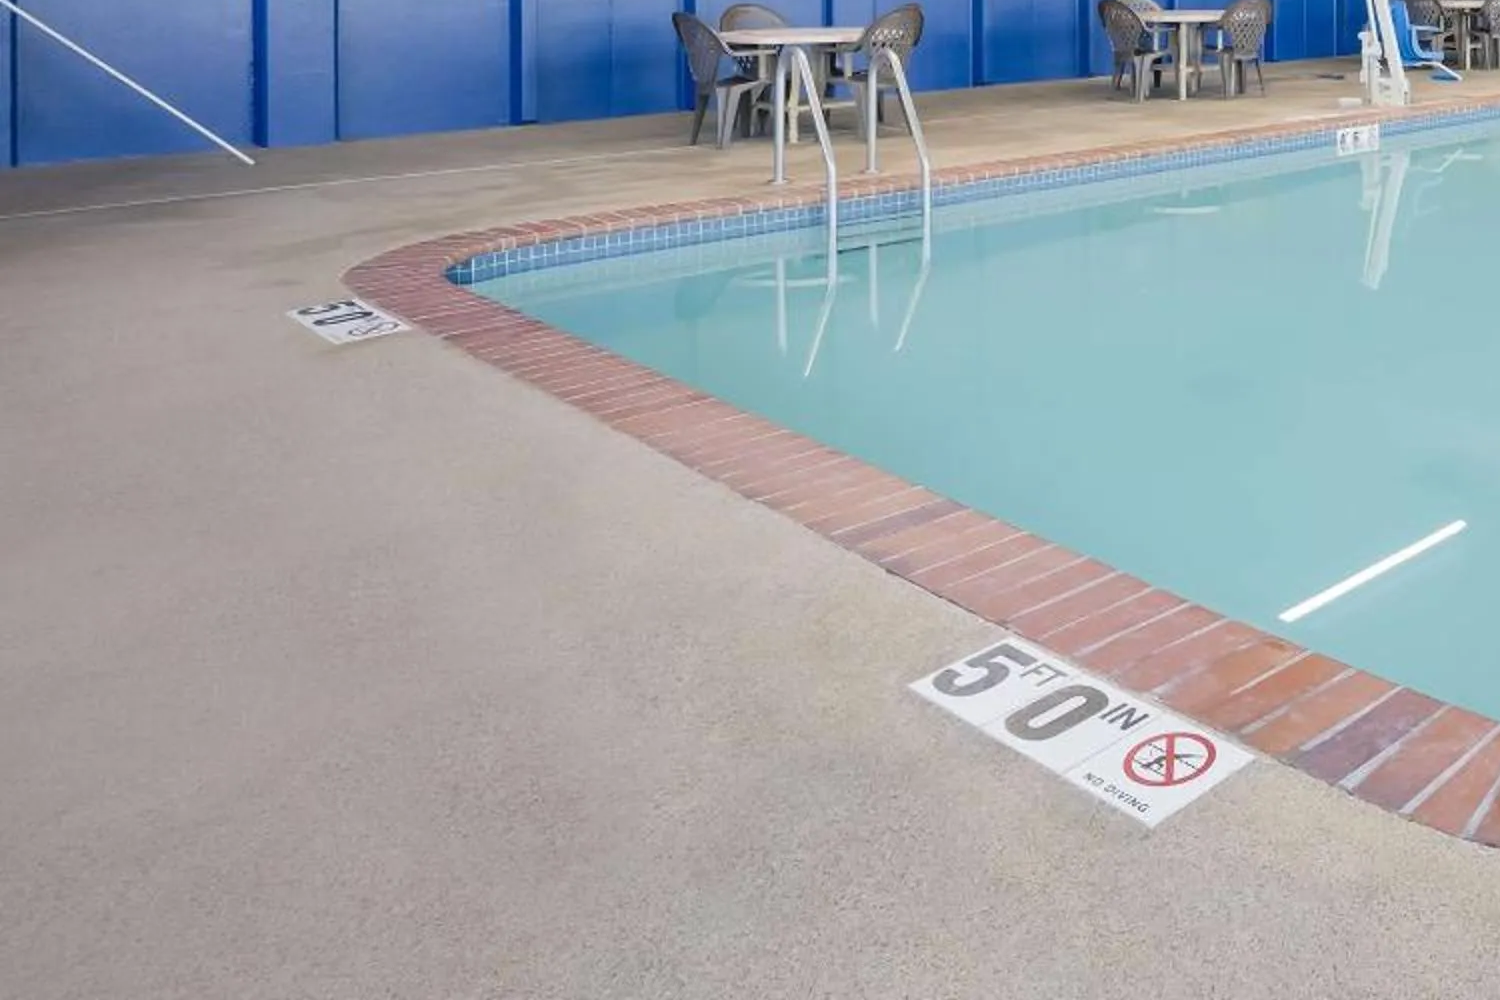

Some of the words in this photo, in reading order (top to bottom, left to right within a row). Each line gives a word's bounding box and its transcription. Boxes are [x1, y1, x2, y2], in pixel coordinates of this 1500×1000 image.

[312, 311, 374, 326] 0
[932, 643, 1038, 697] 5
[1019, 663, 1068, 687] FT
[1004, 684, 1109, 741] 0
[1101, 703, 1149, 732] IN
[1082, 772, 1105, 787] NO
[1103, 784, 1151, 813] DIVING
